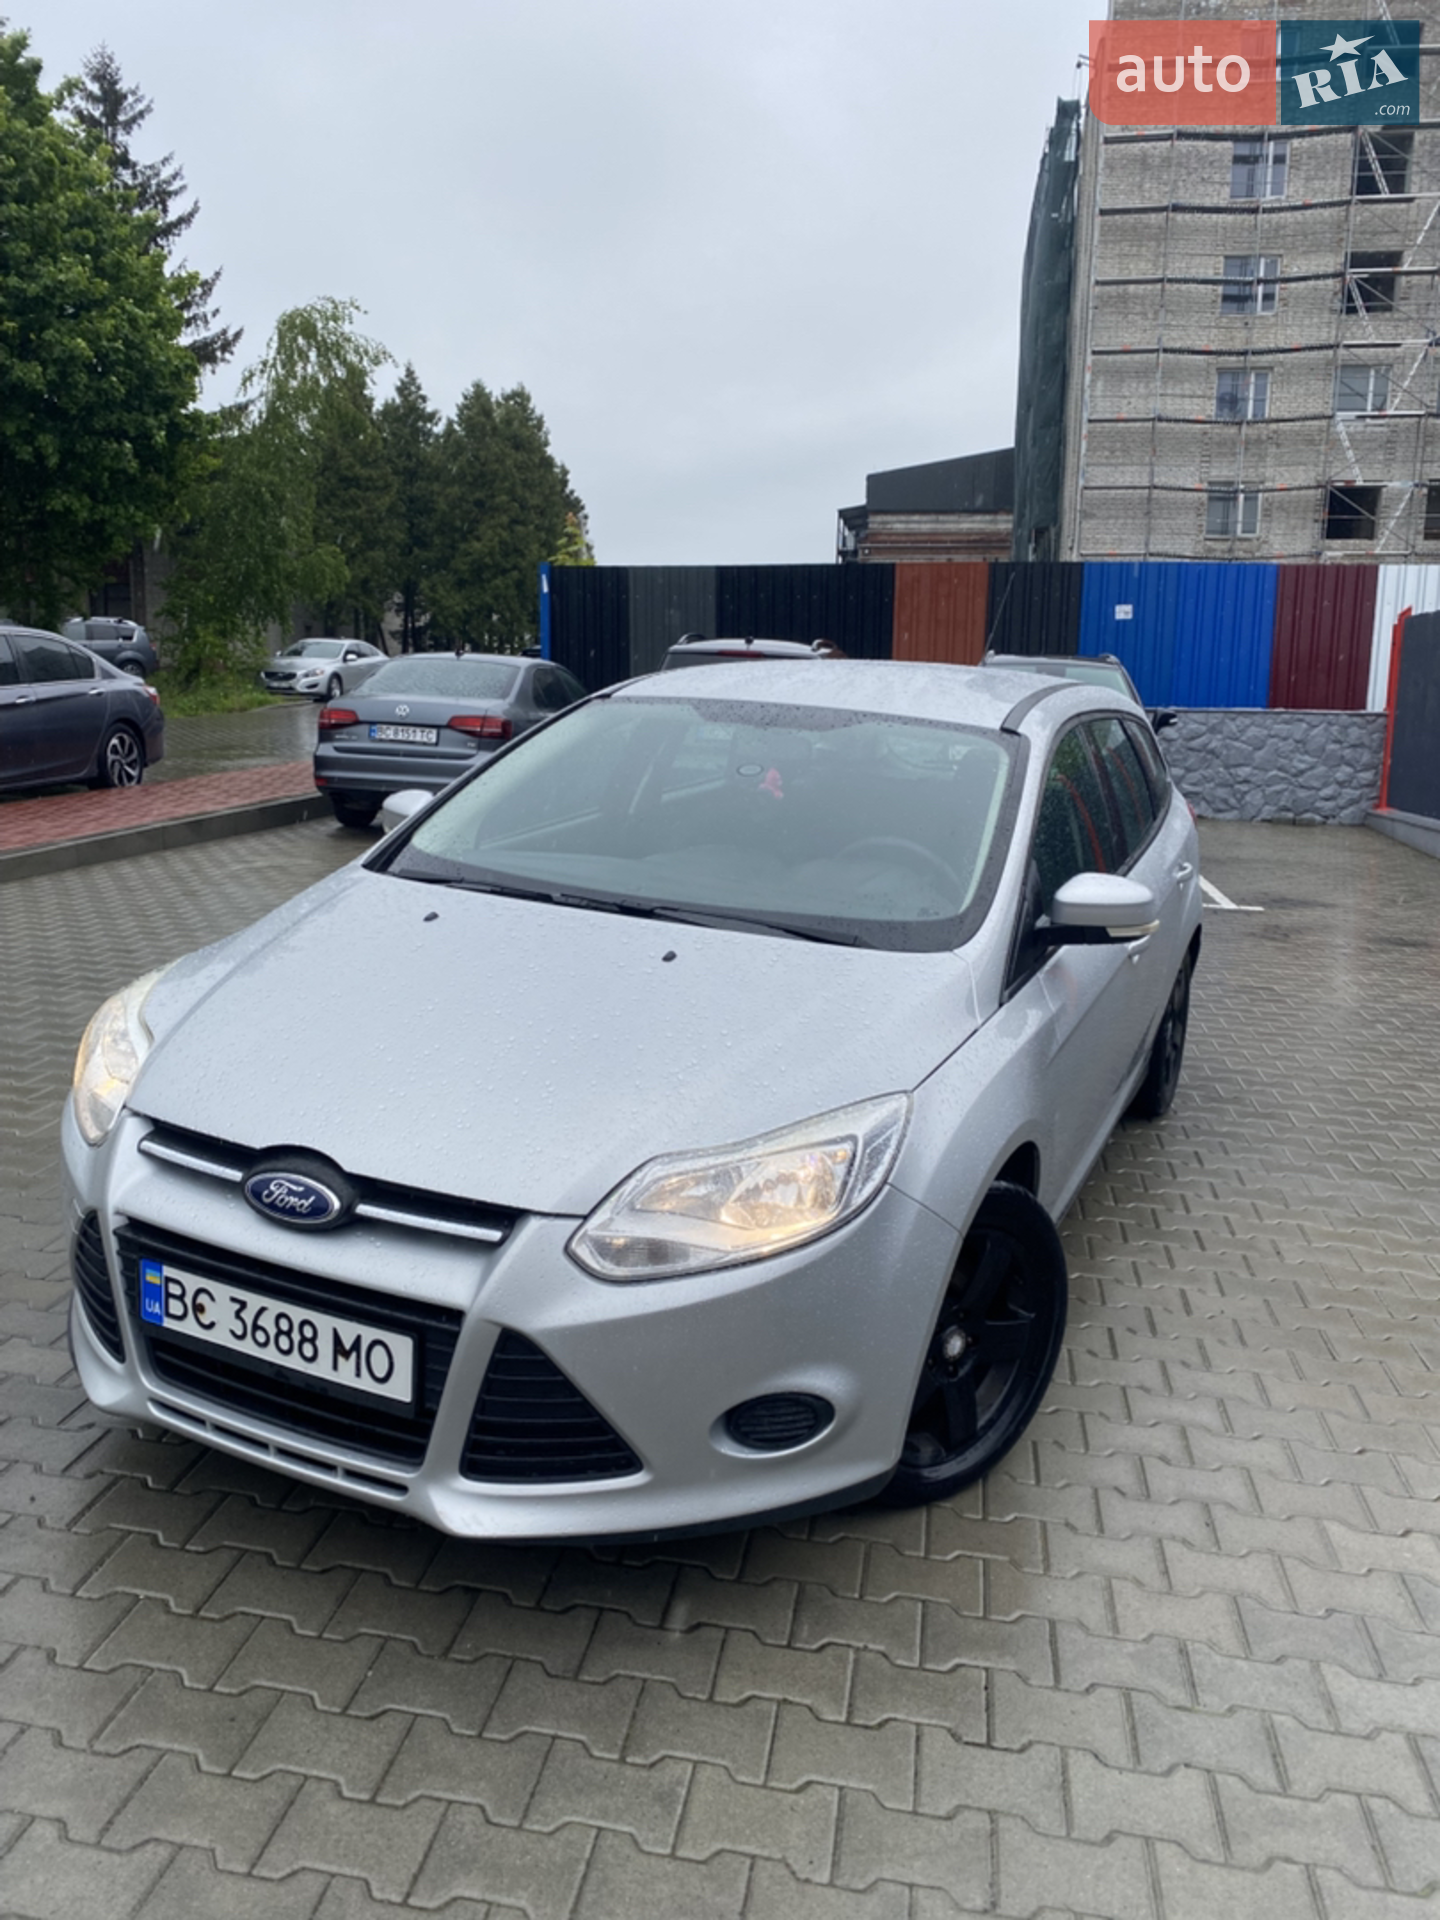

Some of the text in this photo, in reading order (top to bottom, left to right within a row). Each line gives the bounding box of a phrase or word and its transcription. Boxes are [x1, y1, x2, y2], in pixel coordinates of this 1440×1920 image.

[262, 1179, 316, 1214] Ford
[145, 1298, 161, 1315] UA
[164, 1276, 395, 1385] BC 3688 MO
